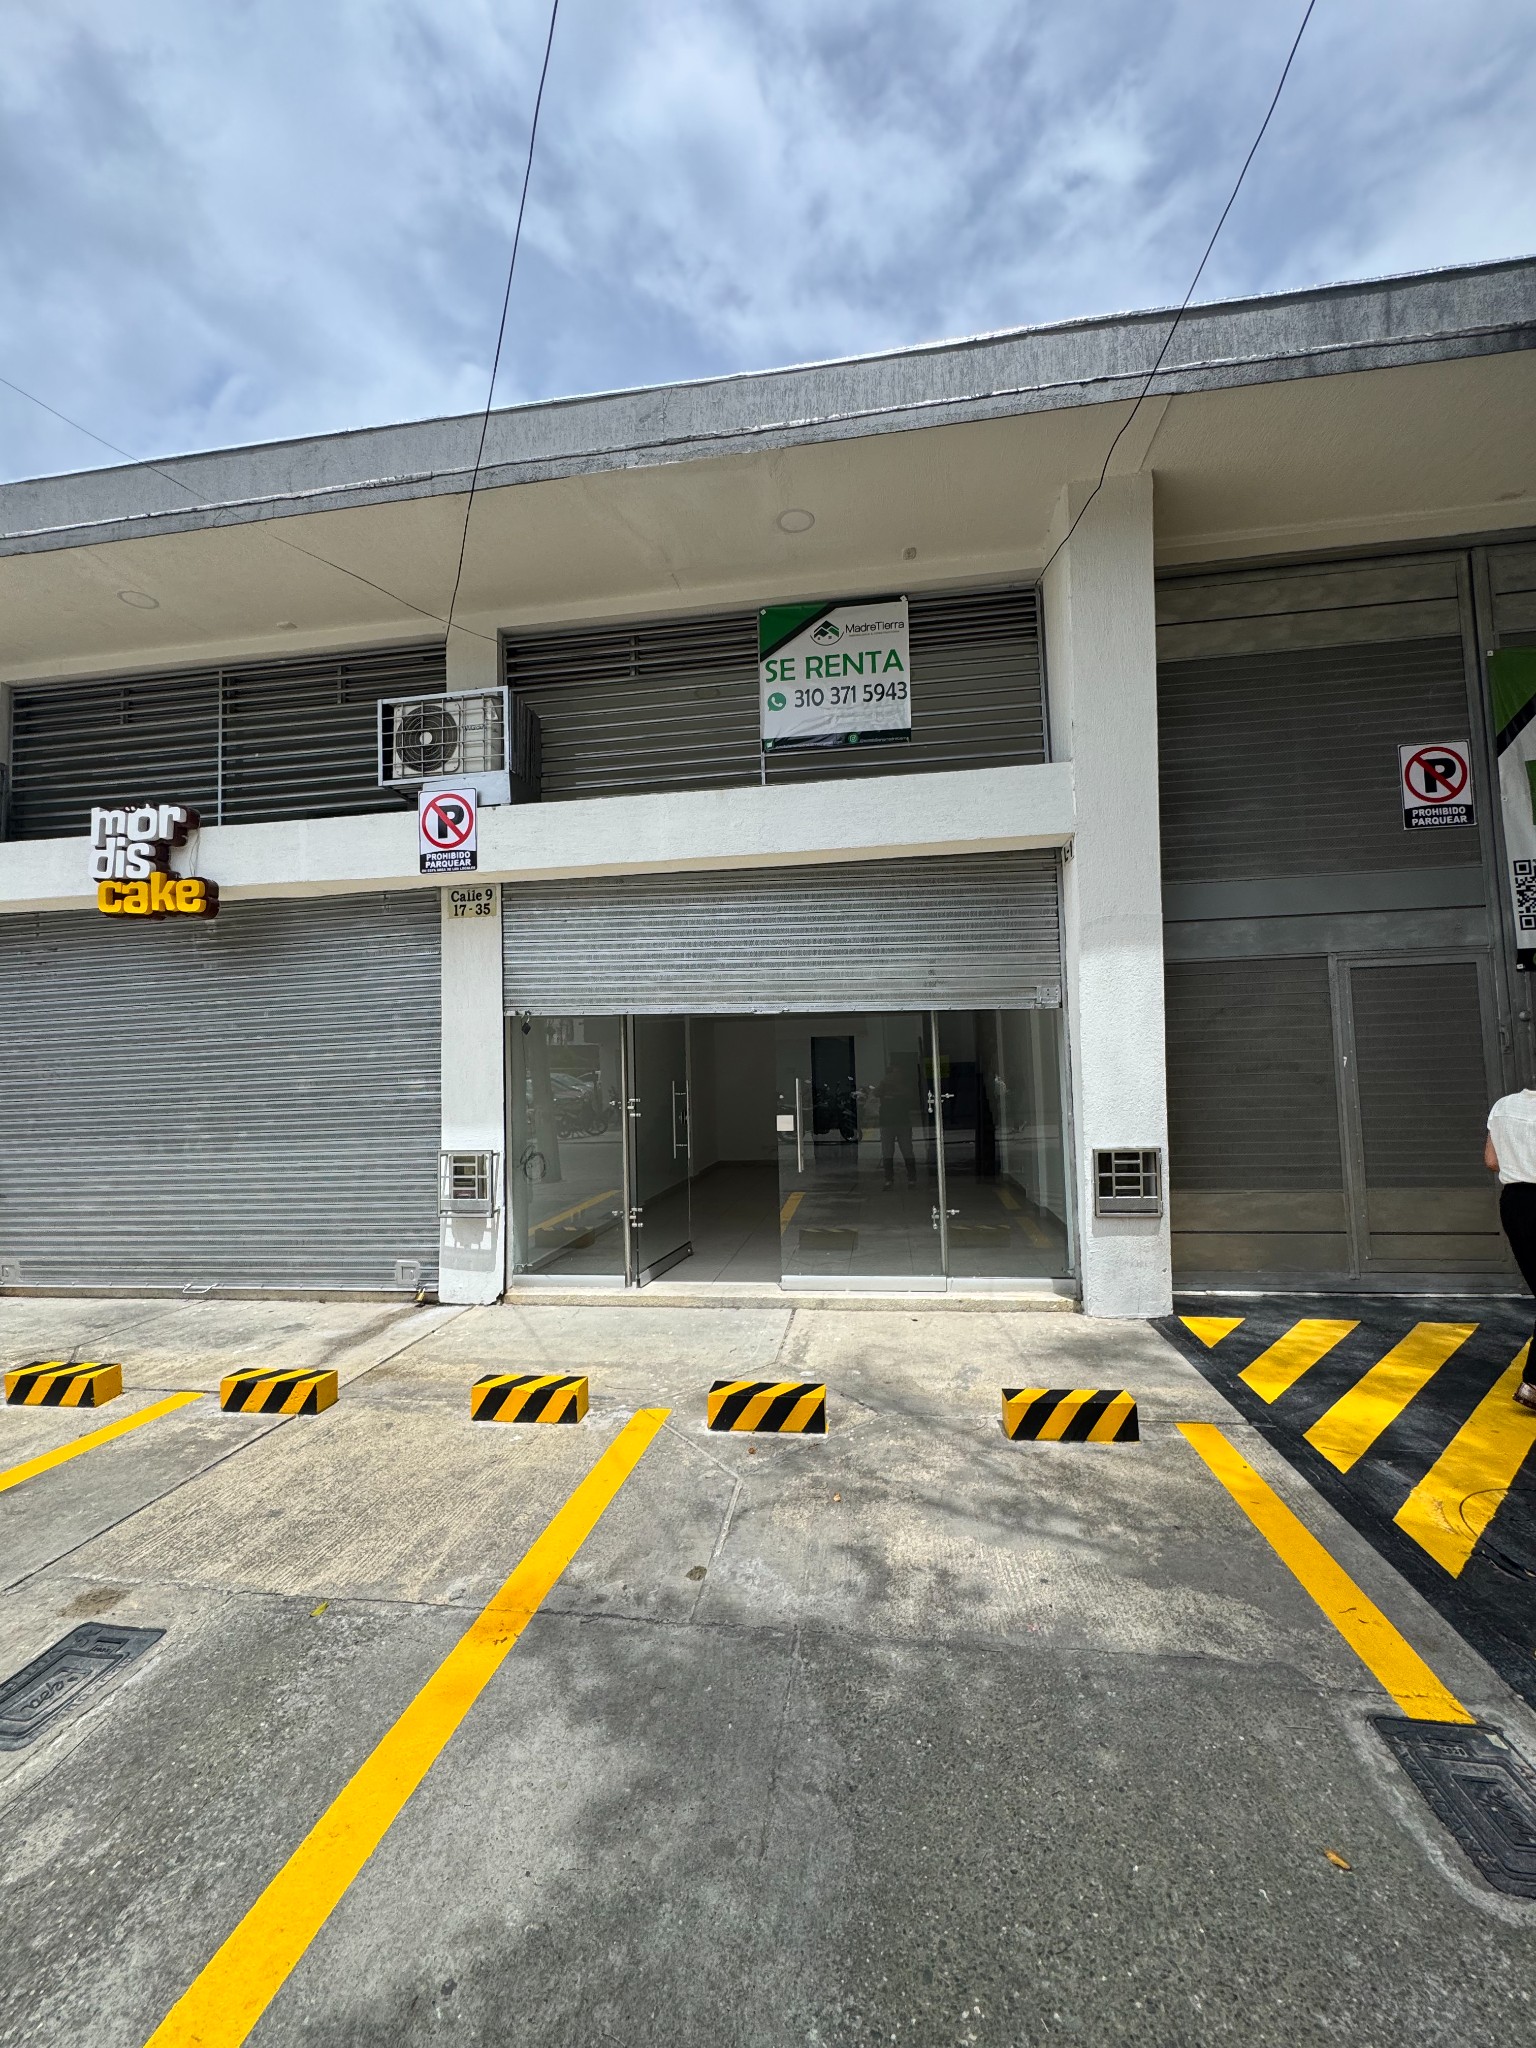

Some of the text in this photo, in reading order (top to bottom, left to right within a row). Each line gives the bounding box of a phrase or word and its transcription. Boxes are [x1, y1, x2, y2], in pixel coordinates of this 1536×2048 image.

[845, 620, 905, 634] MadreTierra
[765, 648, 904, 683] SE RENTA
[794, 681, 908, 708] 310 371 5943
[1412, 806, 1466, 818] PROHIBIDO
[1411, 815, 1468, 826] PARQUEAR
[88, 836, 156, 880] dis
[426, 851, 471, 861] PROHIBIDO
[425, 859, 472, 869] PARQUEAR
[97, 871, 207, 915] cake
[450, 888, 493, 903] Calle 9
